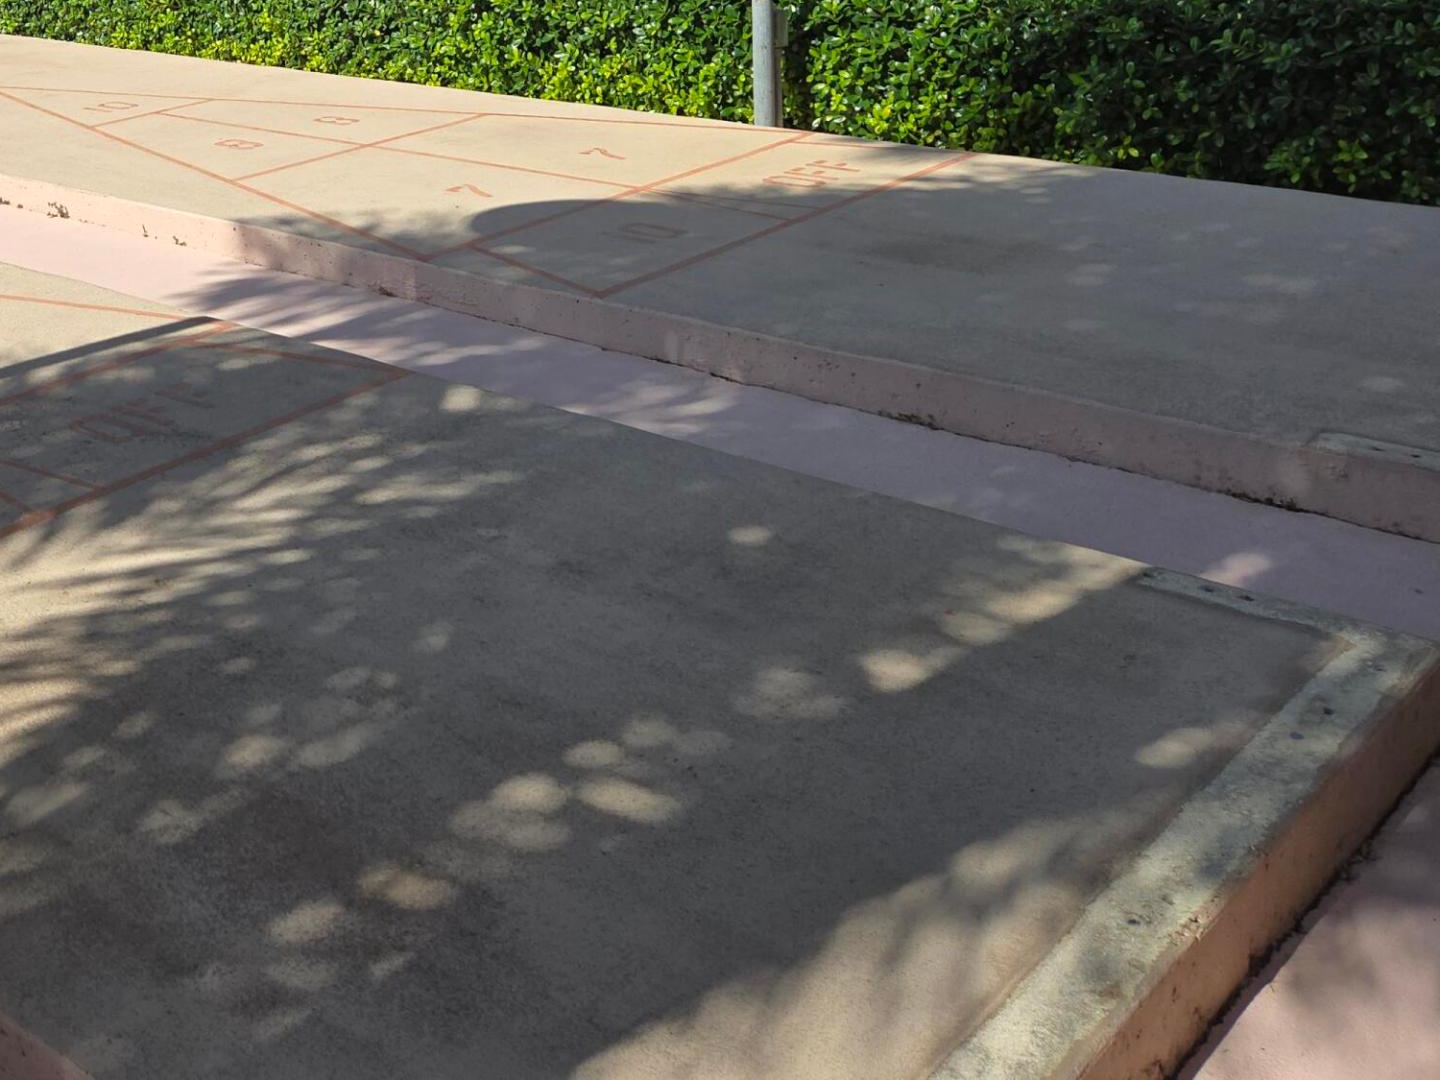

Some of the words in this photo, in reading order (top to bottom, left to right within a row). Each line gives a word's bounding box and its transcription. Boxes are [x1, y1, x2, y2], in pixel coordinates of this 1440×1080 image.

[213, 138, 264, 150] 8
[580, 146, 627, 161] 7
[762, 159, 860, 188] OFF
[443, 183, 494, 198] 7
